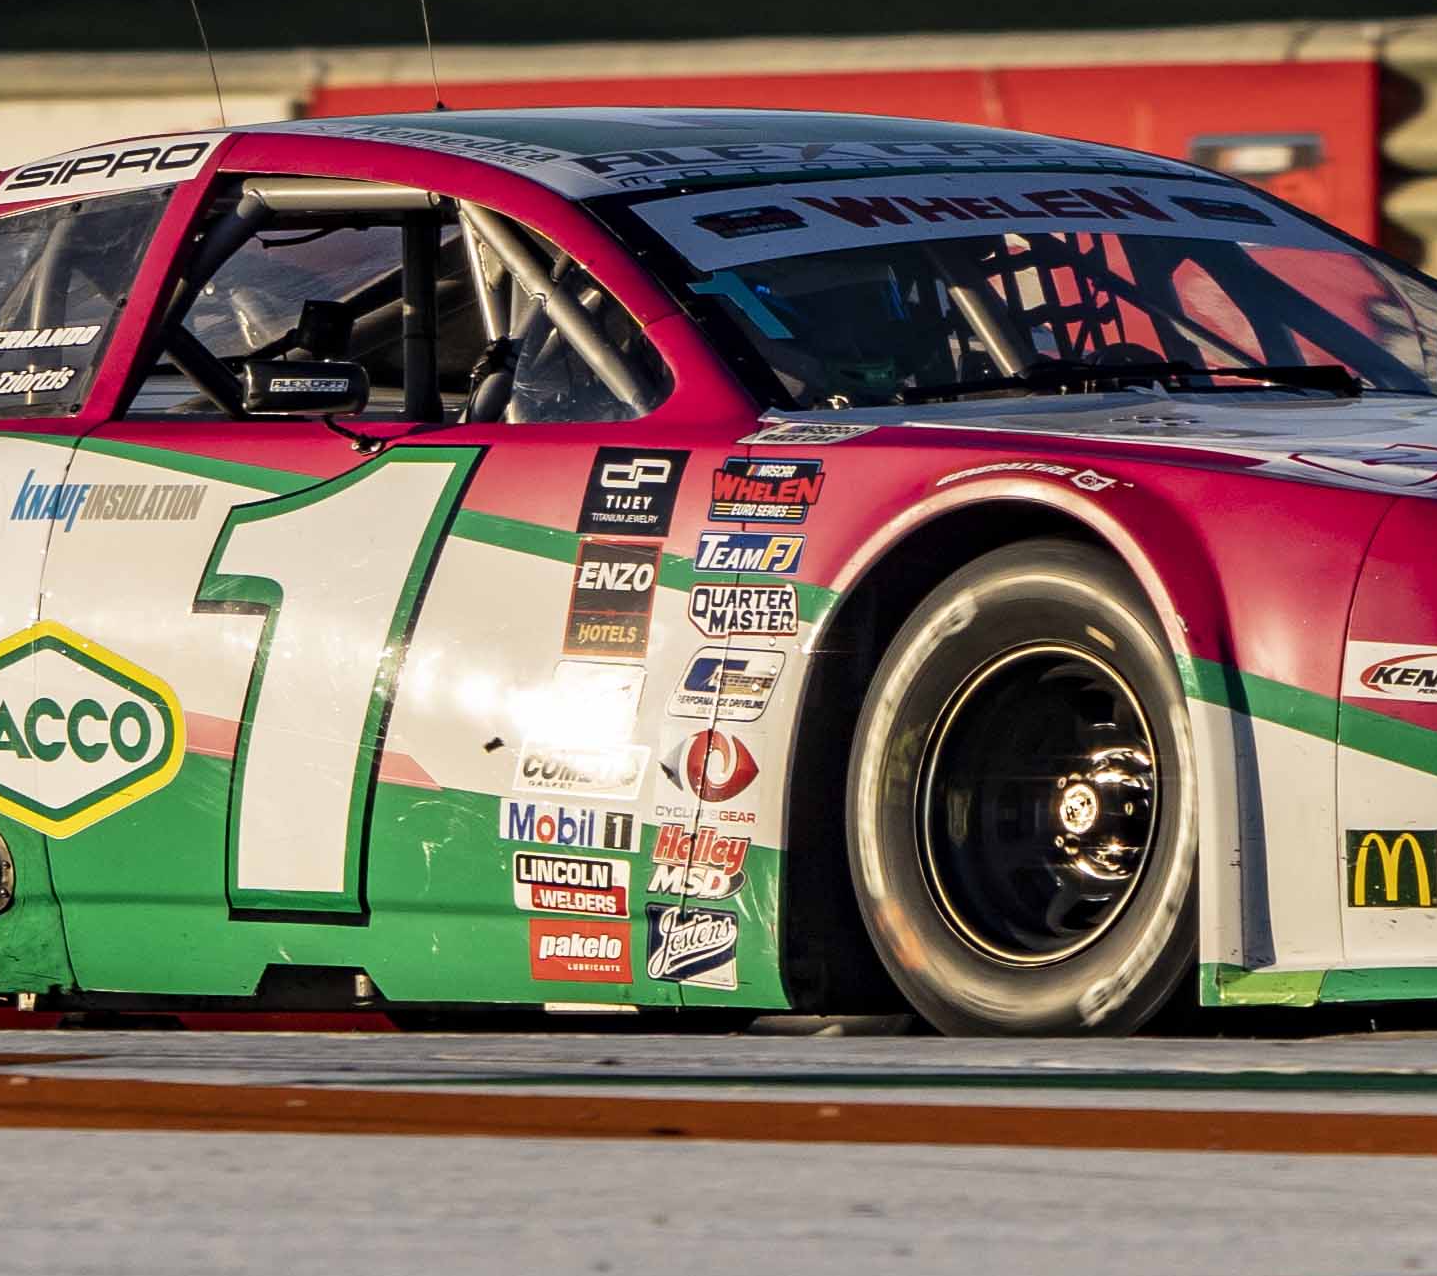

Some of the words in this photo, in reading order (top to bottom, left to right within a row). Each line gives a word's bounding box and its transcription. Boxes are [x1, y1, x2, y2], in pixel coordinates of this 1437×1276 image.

[5, 142, 210, 191] SIPRO
[794, 185, 1178, 229] WHELEN
[10, 468, 89, 533] KNAUF
[82, 484, 209, 522] INSULATION
[605, 495, 653, 510] TIJEY
[714, 473, 826, 505] WHELEN
[730, 504, 755, 516] EURO
[755, 505, 789, 518] SERIES
[578, 562, 654, 592] ENZO
[692, 587, 793, 618] QUARTER
[578, 623, 638, 643] HOTELS
[708, 609, 795, 633] MASTER
[194, 444, 486, 925] 1
[508, 802, 595, 847] Mobil
[653, 823, 751, 874] Holley
[518, 858, 610, 889] LINCOLN
[647, 864, 732, 898] MSD
[539, 888, 618, 914] WELDERS
[539, 933, 622, 960] pakelo
[648, 907, 737, 979] Jostens
